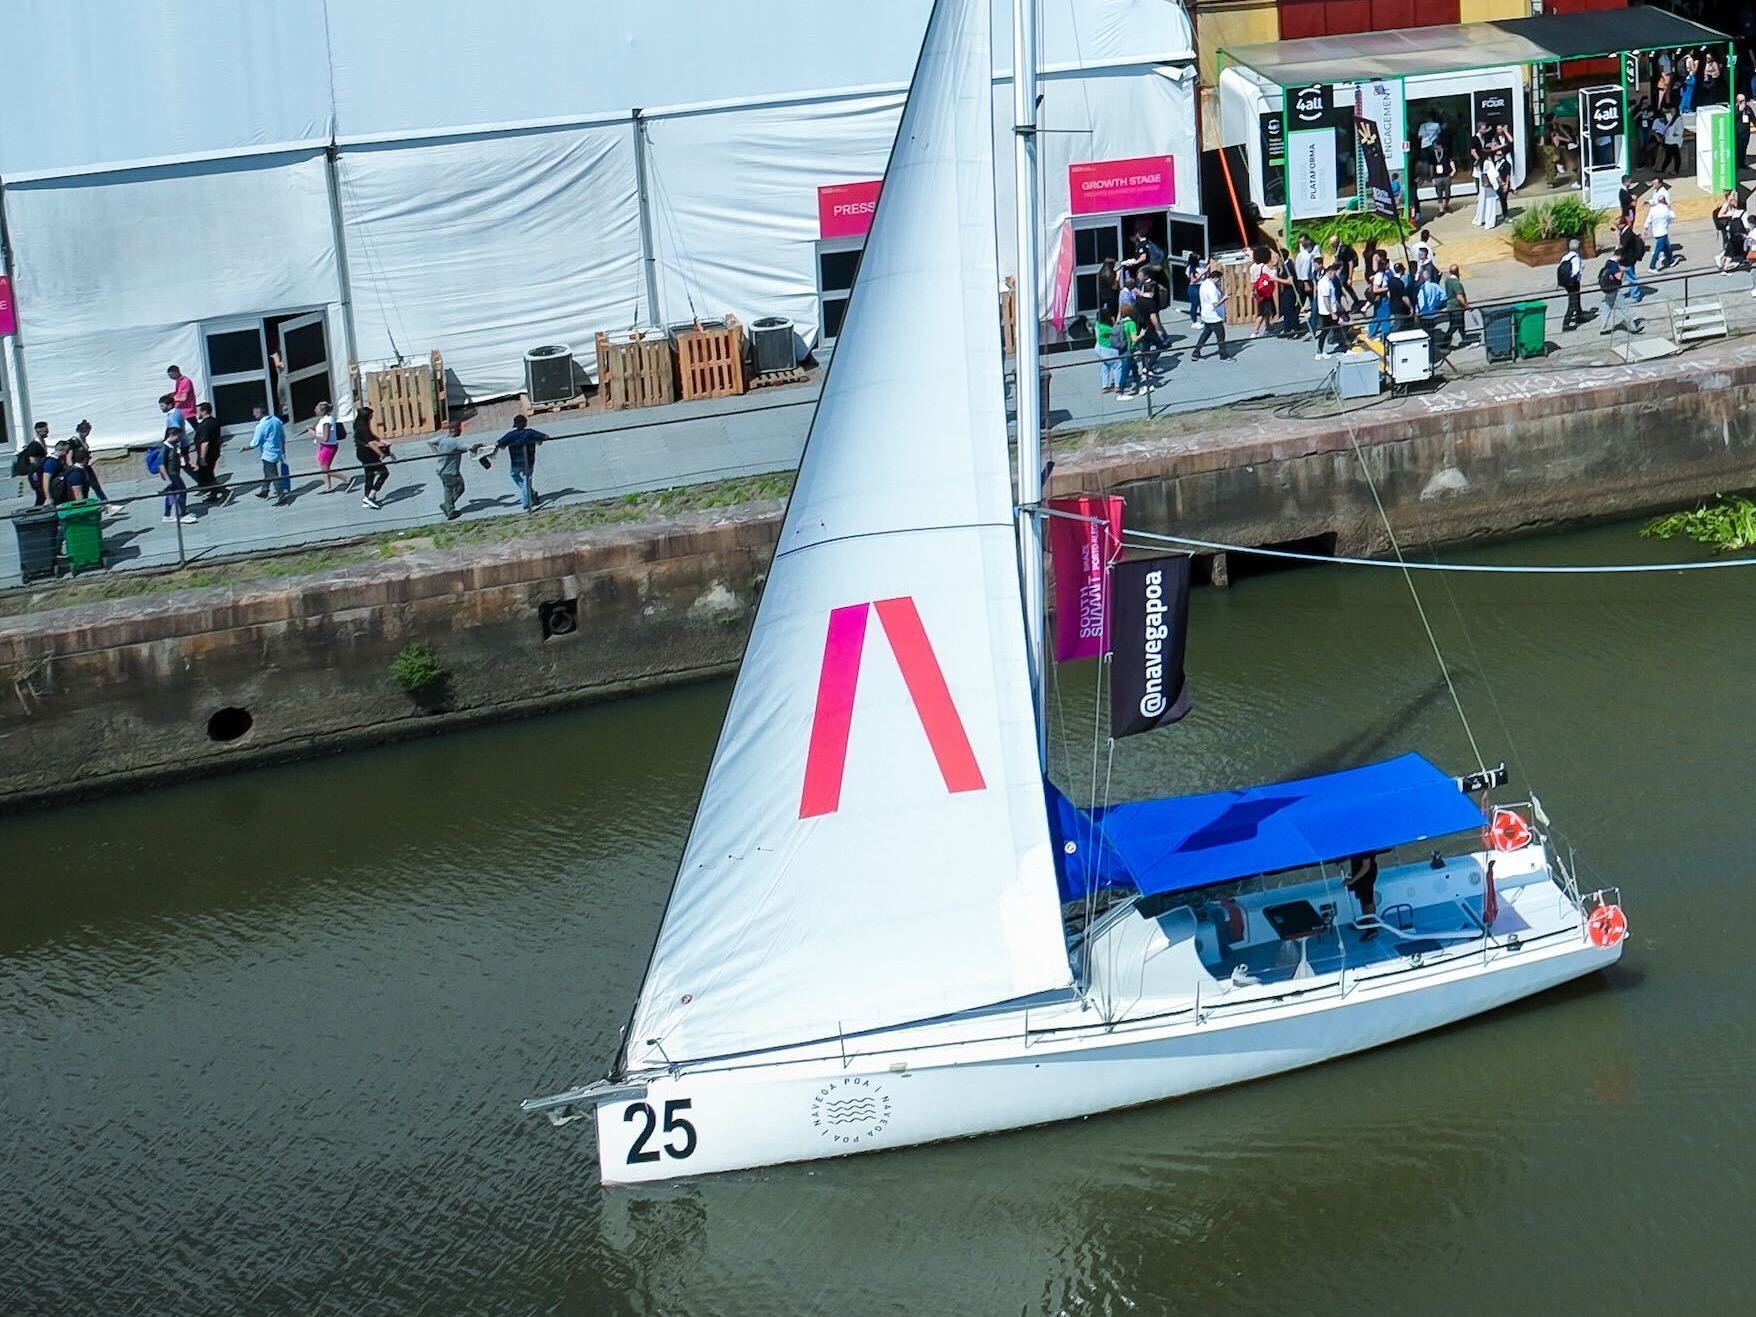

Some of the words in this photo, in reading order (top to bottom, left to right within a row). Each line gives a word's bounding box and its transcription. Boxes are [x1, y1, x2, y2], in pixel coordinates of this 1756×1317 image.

[1594, 107, 1619, 121] 4all
[1082, 178, 1128, 191] GROWTH
[1129, 174, 1161, 185] STAGE
[1309, 143, 1317, 200] PLATAFORMA
[833, 201, 876, 216] PRESS
[1080, 586, 1092, 638] SOUTH
[1088, 575, 1103, 637] SUMMIT
[1140, 570, 1168, 718] @navegapoa
[844, 1077, 870, 1087] POA
[623, 1098, 698, 1165] 25
[834, 1135, 860, 1143] POA
